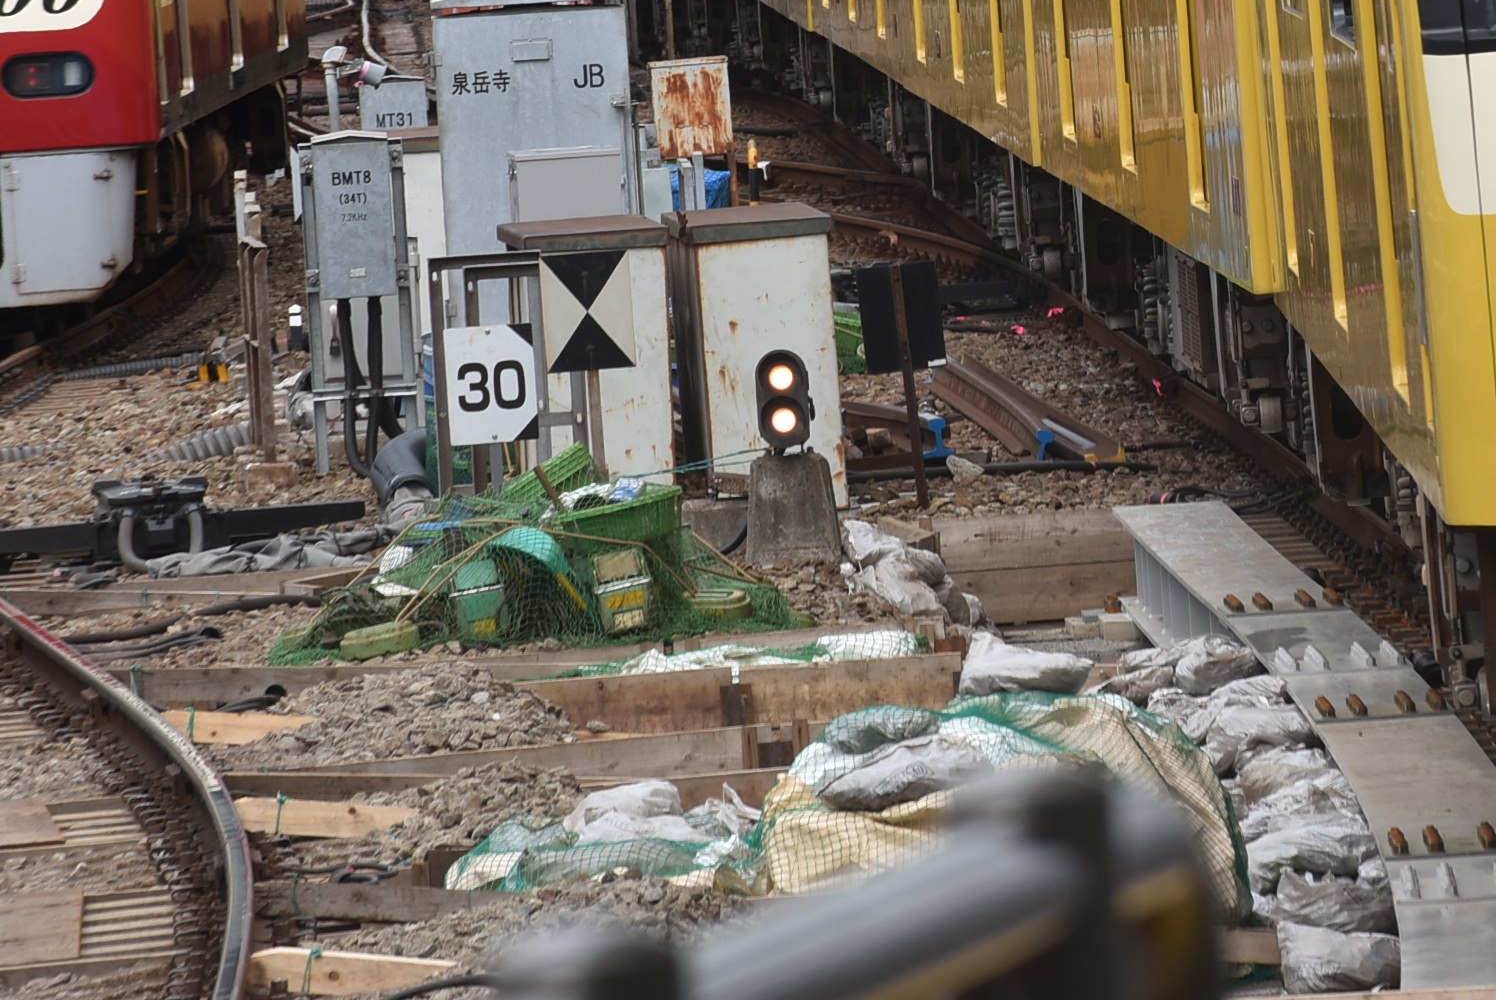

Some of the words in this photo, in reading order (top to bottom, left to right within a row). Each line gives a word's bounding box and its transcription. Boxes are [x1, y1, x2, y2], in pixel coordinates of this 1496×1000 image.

[451, 69, 511, 96] 泉岳寺
[573, 63, 606, 89] JB
[376, 112, 414, 128] MT31
[331, 170, 372, 187] BMT8
[339, 192, 368, 206] (34T)
[457, 359, 526, 412] 30
